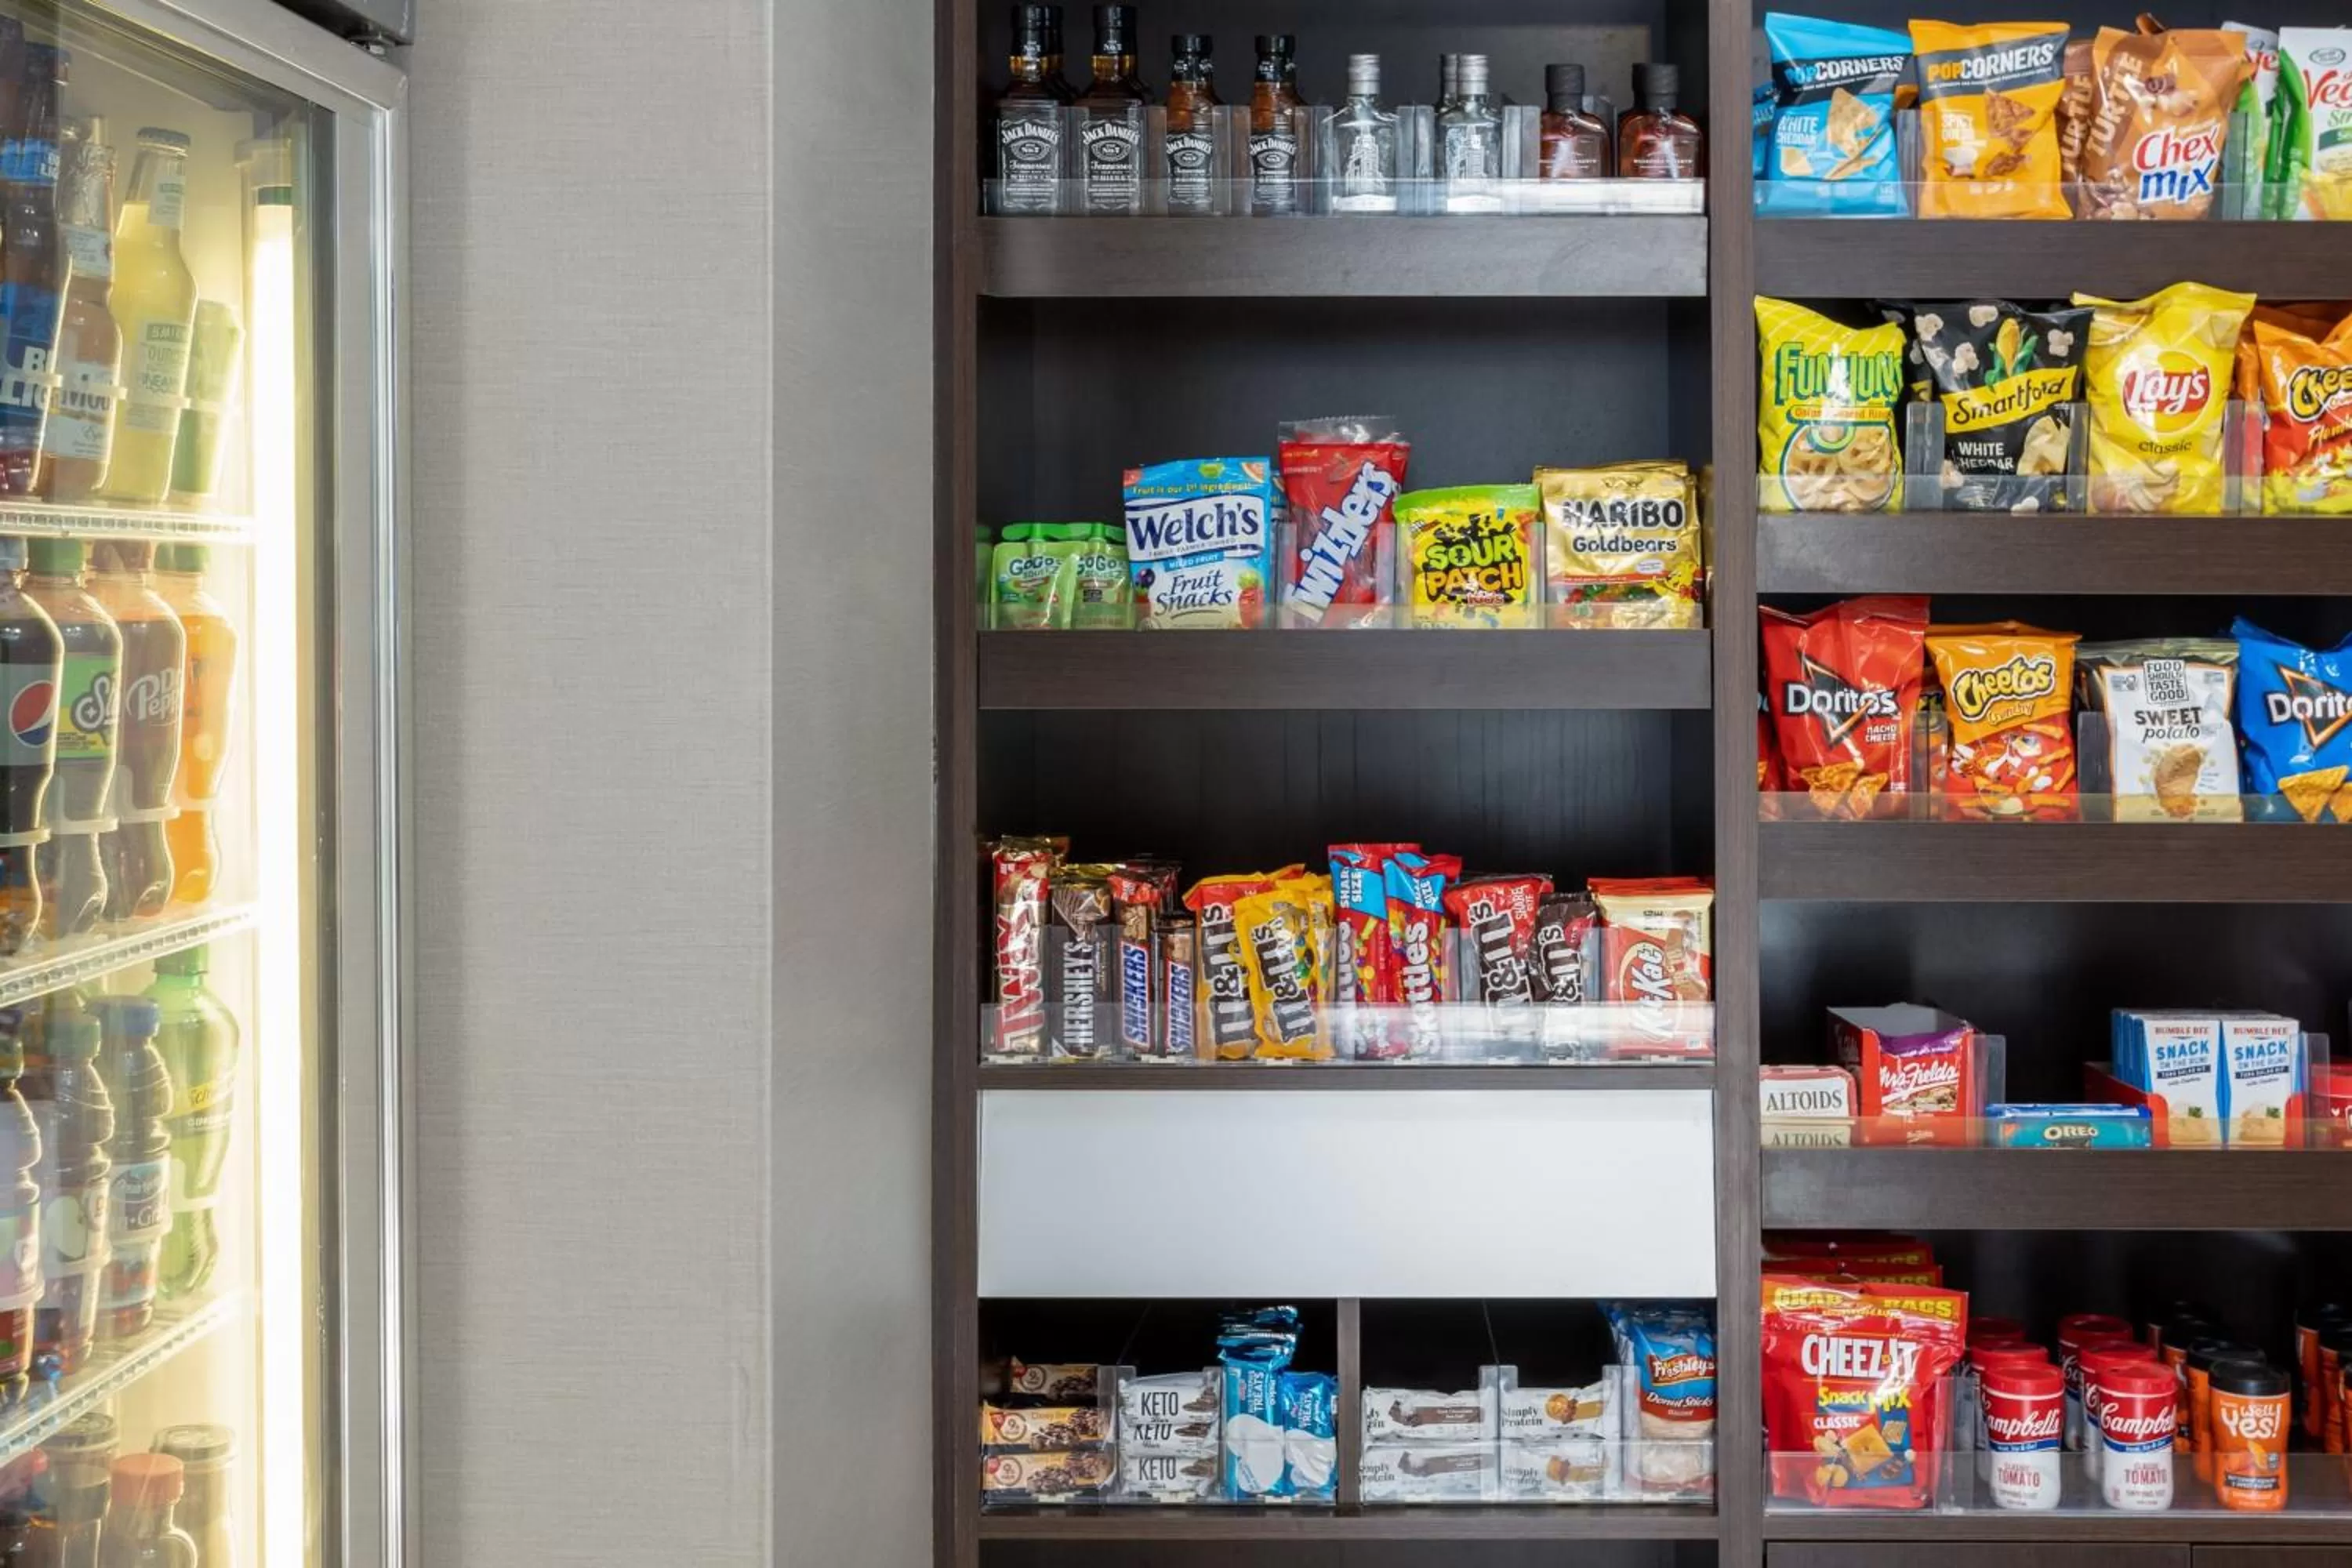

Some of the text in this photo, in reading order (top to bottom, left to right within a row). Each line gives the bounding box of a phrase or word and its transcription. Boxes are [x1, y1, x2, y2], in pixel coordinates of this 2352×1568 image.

[1928, 43, 2055, 83] POPCORNERS
[2135, 123, 2220, 171] Chex
[2140, 161, 2214, 201] mix
[2124, 364, 2209, 416] Lay's
[1958, 441, 2005, 456] WHITE
[2138, 439, 2193, 455] Classic
[1562, 499, 1684, 528] HARIBO
[1127, 503, 1259, 551] Welch's
[1426, 534, 1515, 571] SOUR
[1572, 536, 1677, 553] Goldbears
[1171, 568, 1224, 597] Fruit
[1425, 561, 1523, 600] PATCH
[1154, 588, 1233, 616] Snacks
[2147, 661, 2182, 673] FOOD
[1955, 658, 2053, 717] Cheetos
[2149, 681, 2183, 691] TASTE
[2150, 689, 2185, 702] GOOD
[1788, 684, 1898, 716] Doritos
[2134, 706, 2201, 725] SWEET
[1123, 943, 1148, 1044] SNICKERS
[1169, 965, 1192, 1052] SNICKERS
[2156, 1040, 2210, 1061] SNACK
[2234, 1040, 2288, 1061] SNACK
[1766, 1090, 1842, 1112] ALTOIDS
[2043, 1125, 2099, 1141] OREO
[1142, 1392, 1178, 1417] KETO
[1134, 1423, 1173, 1440] KETO
[1813, 1416, 1860, 1429] CLASSIC
[1139, 1457, 1176, 1481] KETO
[1998, 1467, 2041, 1487] TOMATO
[2124, 1468, 2167, 1485] TOMATO
